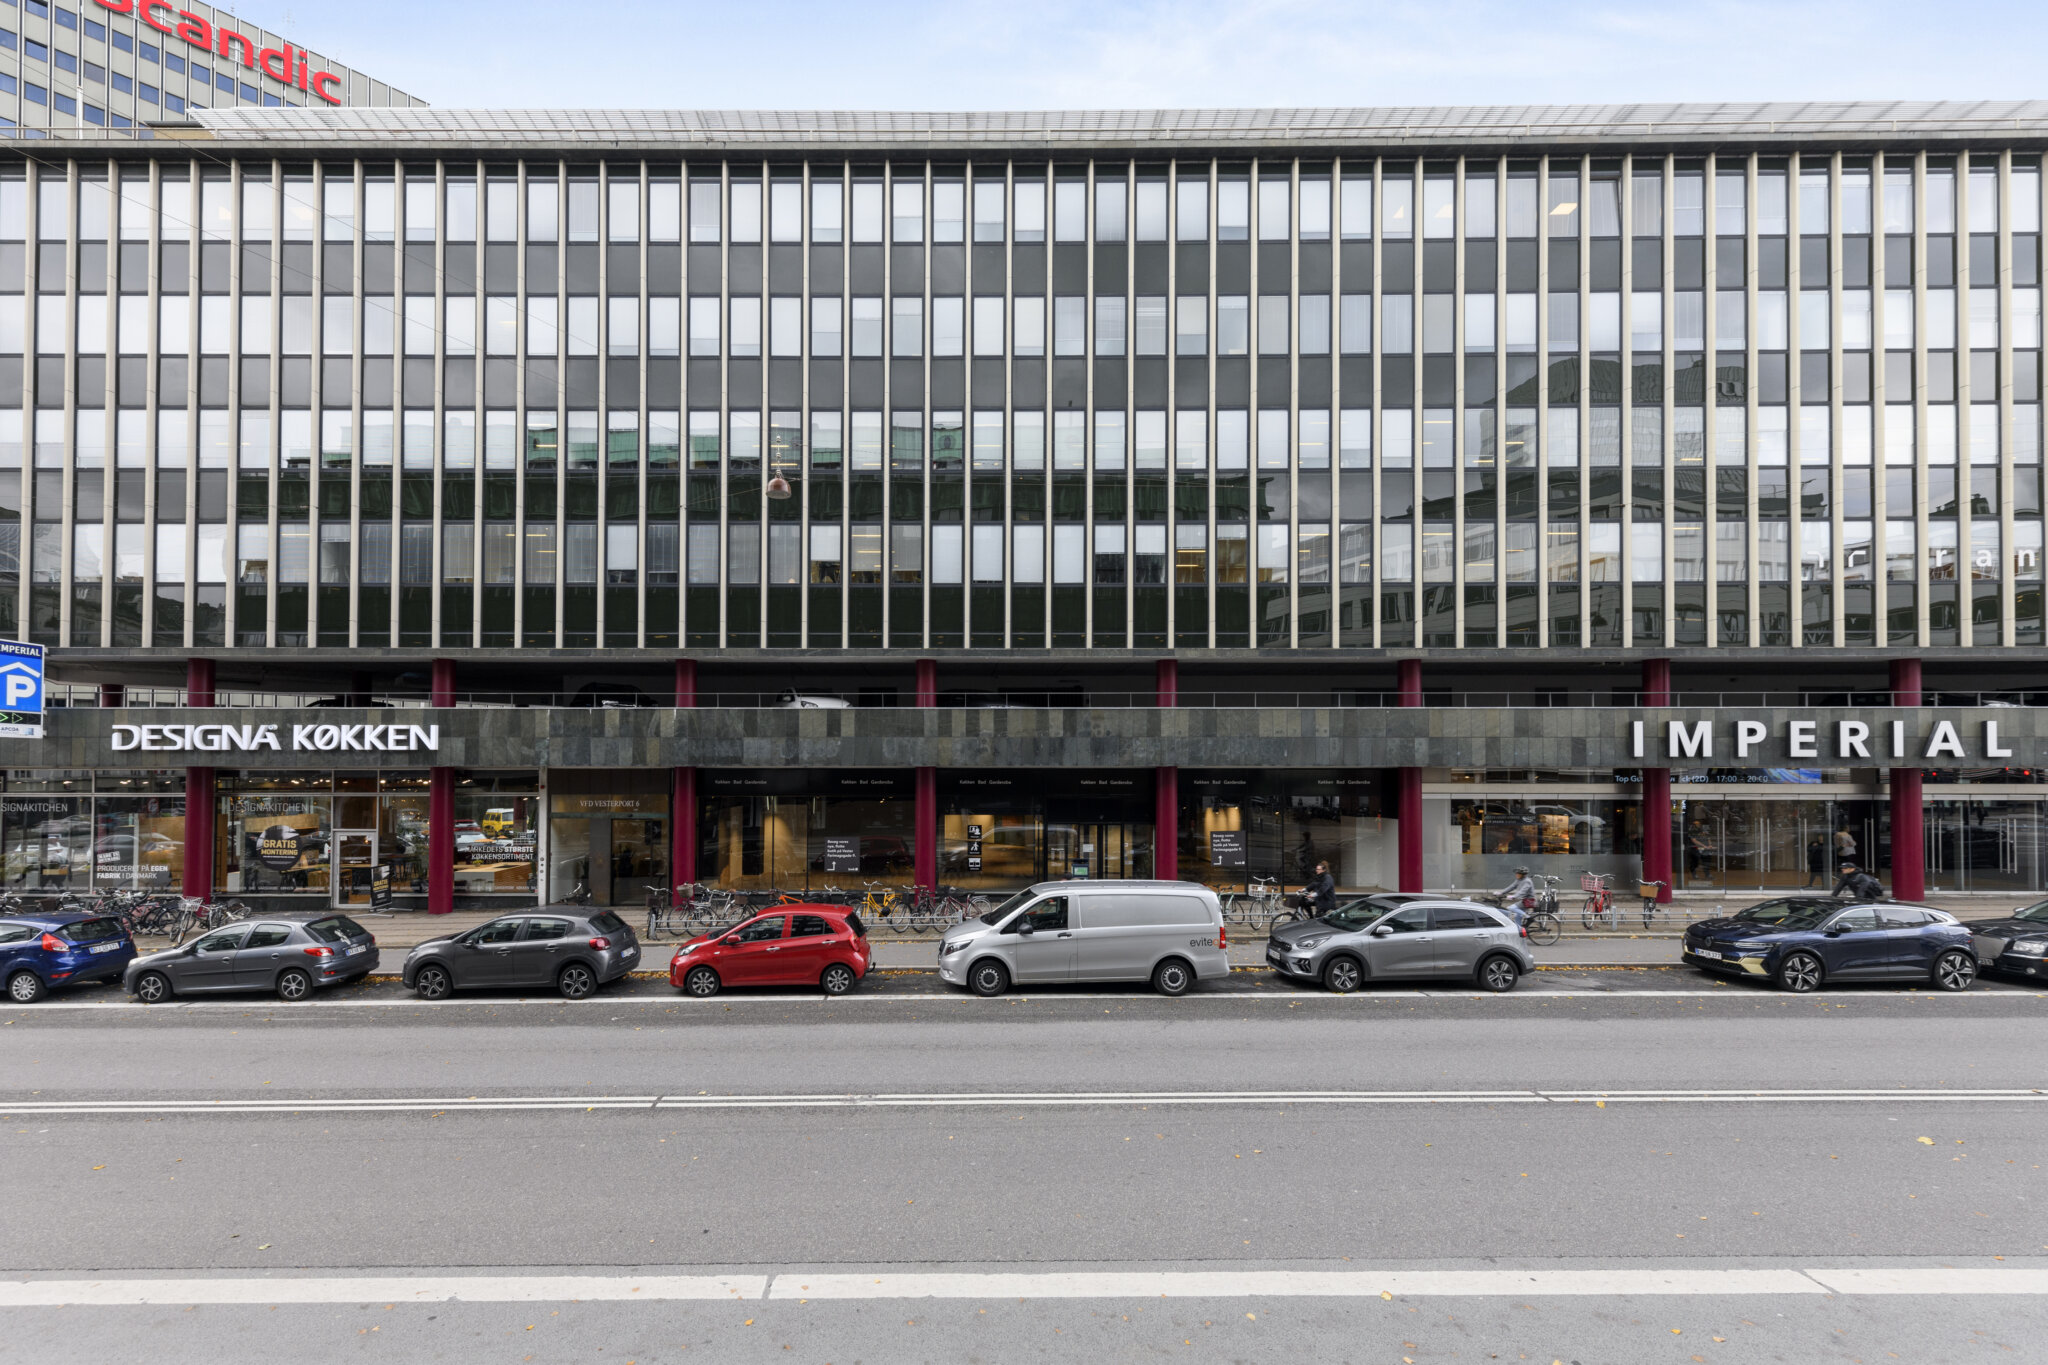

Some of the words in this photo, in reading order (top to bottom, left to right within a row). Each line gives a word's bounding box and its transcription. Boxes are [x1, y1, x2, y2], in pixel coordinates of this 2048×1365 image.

[0, 643, 41, 657] MPERIAL
[6, 674, 36, 706] P
[293, 724, 439, 750] KØKKEN
[1633, 720, 2012, 757] IMPERIAL
[1615, 775, 1629, 784] Top
[1630, 775, 1643, 783] Gu
[1717, 775, 1737, 783] 17:00
[263, 839, 297, 849] GRATIS
